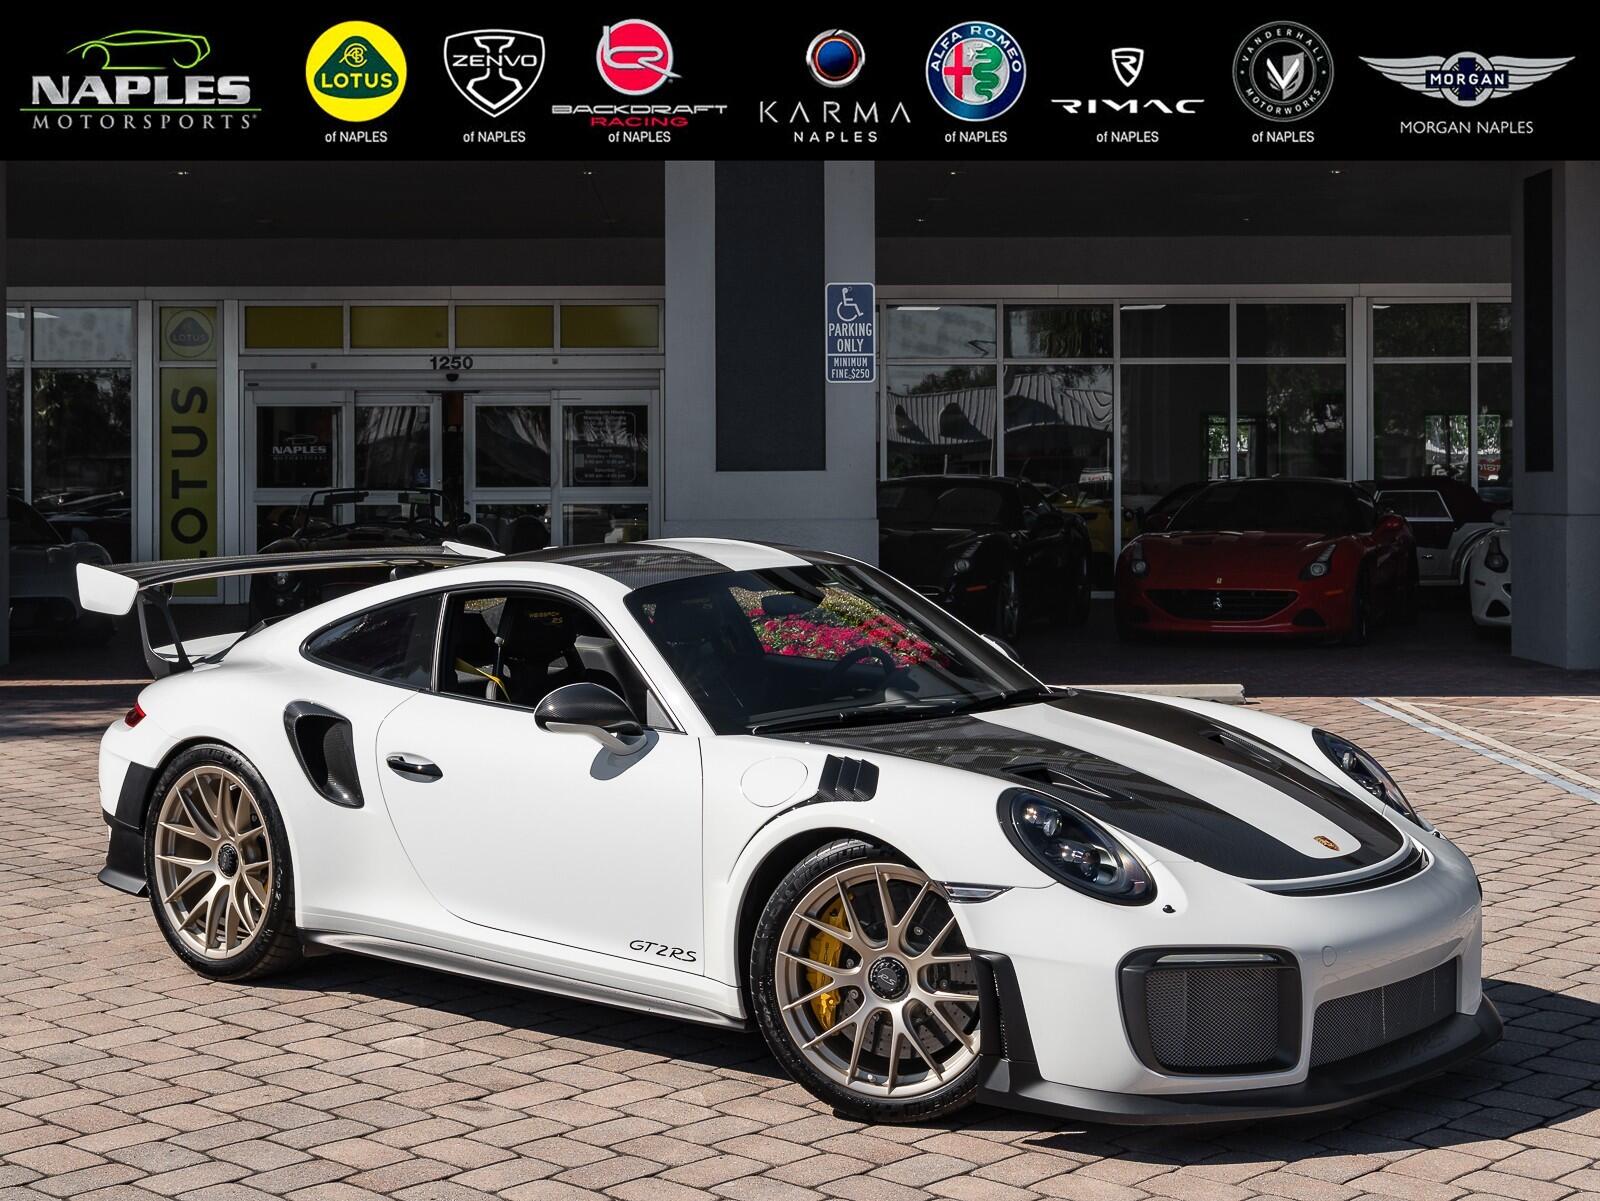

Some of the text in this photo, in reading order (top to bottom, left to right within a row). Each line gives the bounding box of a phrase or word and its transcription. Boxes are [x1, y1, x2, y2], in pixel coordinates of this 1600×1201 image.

[828, 322, 873, 337] PARKING
[172, 333, 208, 342] LOTUS
[837, 338, 864, 352] ONLY
[429, 356, 474, 370] 1250
[833, 357, 868, 367] MINIMUM
[831, 368, 870, 379] FINE $250
[272, 445, 327, 455] NAPLES
[171, 385, 208, 557] OTUS
